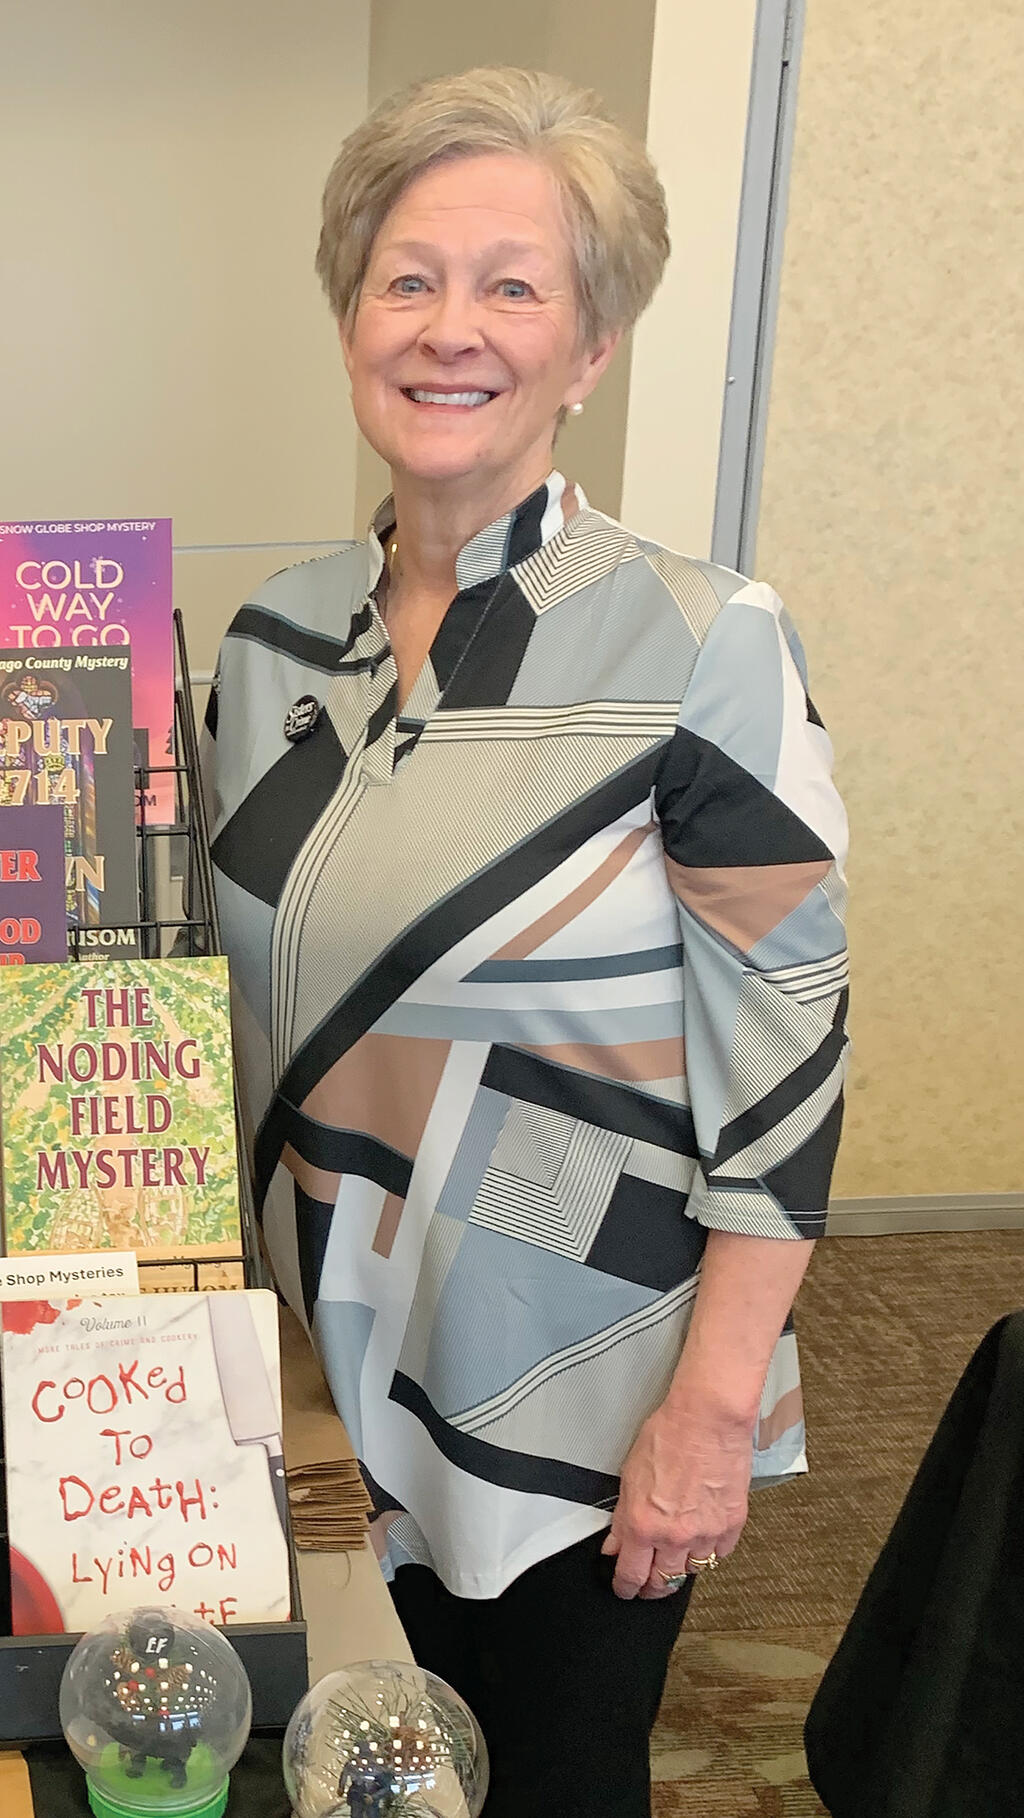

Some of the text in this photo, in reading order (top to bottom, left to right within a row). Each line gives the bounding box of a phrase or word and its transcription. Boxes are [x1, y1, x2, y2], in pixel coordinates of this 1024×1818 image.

[0, 524, 34, 535] SNOW
[36, 523, 72, 534] GLOBE
[74, 522, 106, 533] SHOP
[107, 520, 156, 532] MYSTERY
[15, 558, 124, 590] COLD
[26, 591, 114, 622] WAY
[9, 623, 130, 649] TO GO
[25, 657, 73, 671] County
[74, 655, 128, 669] Mystery
[81, 988, 153, 1028] THE
[37, 1040, 201, 1083] NODING
[70, 1095, 172, 1136] FIELD
[37, 1147, 210, 1191] MYSTERY
[6, 1272, 45, 1288] Shop
[50, 1267, 123, 1283] Mysteries
[80, 1316, 131, 1333] Volume
